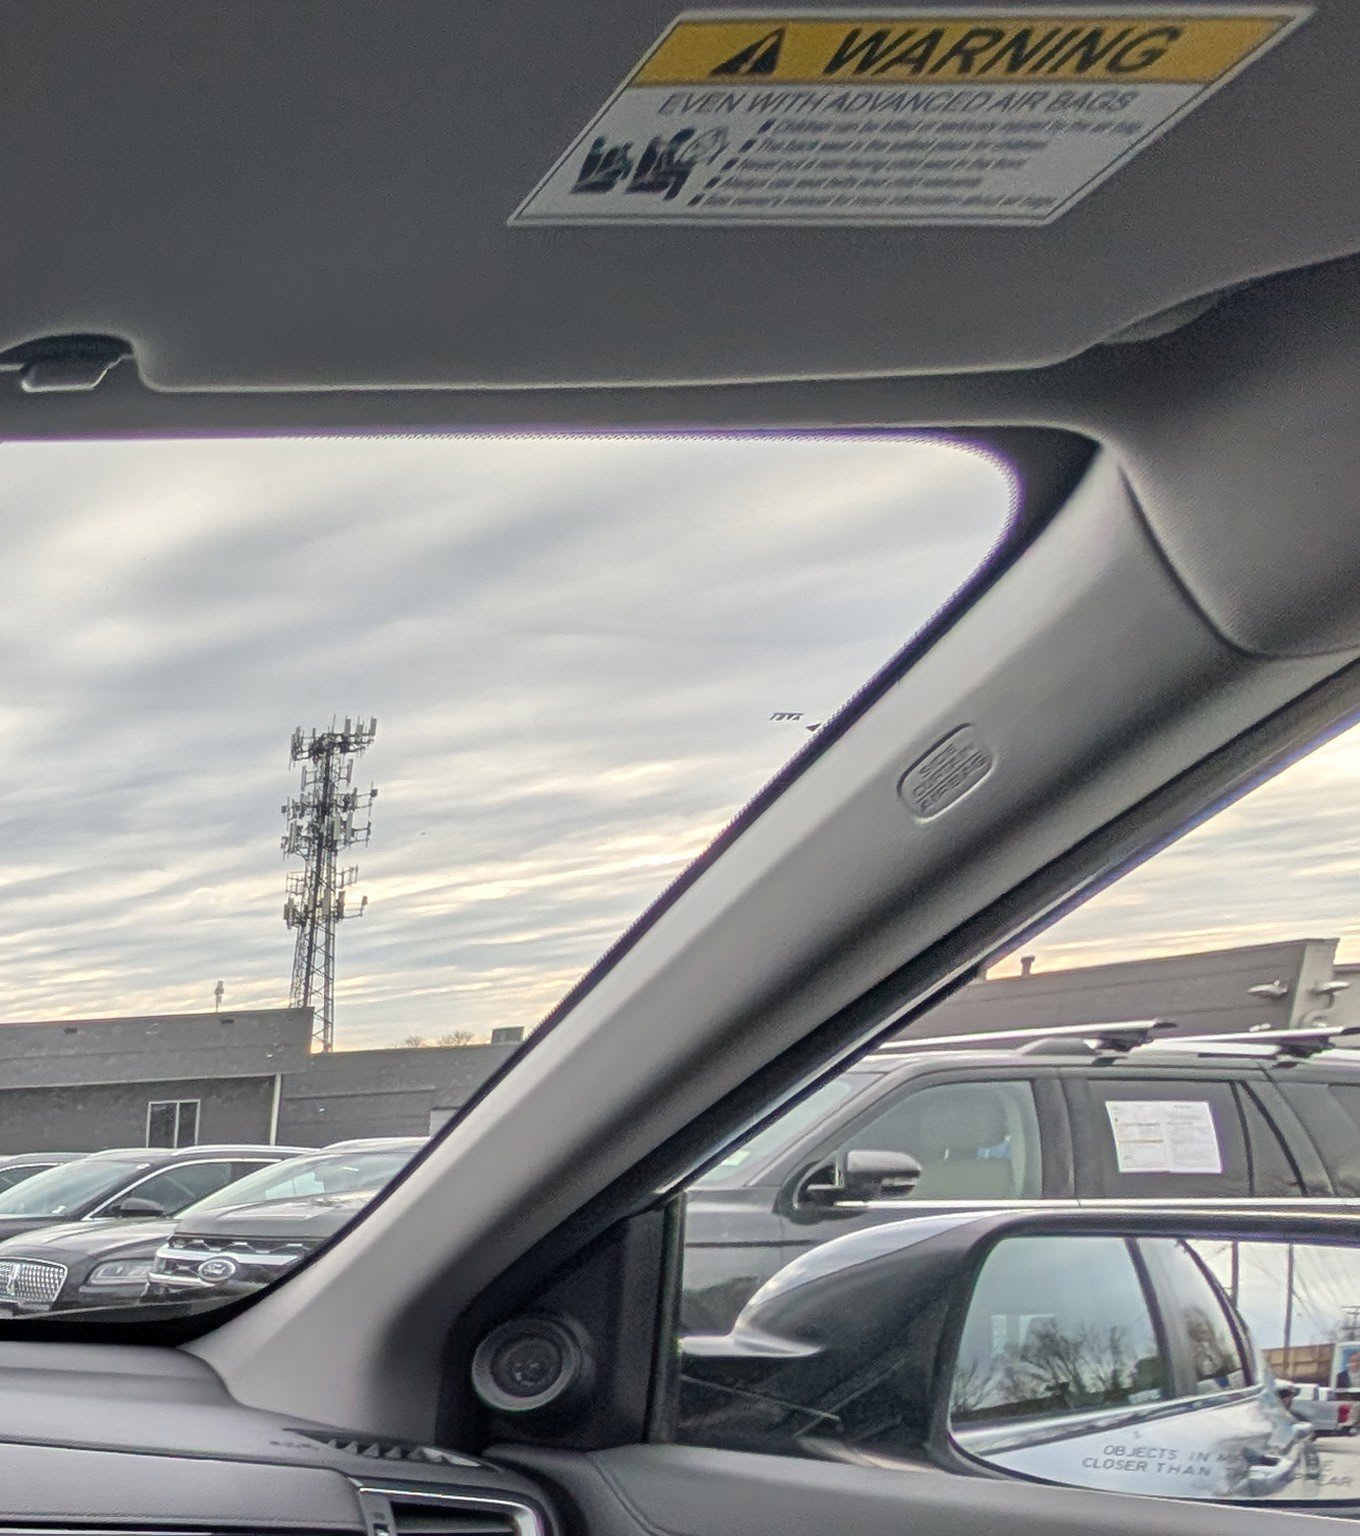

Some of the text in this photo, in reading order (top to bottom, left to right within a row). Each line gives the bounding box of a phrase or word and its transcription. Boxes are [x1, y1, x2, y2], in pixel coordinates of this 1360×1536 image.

[821, 26, 1183, 76] WARNING
[659, 91, 1140, 114] EVEN WITH ADVANCED AIR BAGS
[1103, 1444, 1178, 1460] OBJECTS
[1189, 1451, 1210, 1462] IN
[1081, 1457, 1212, 1477] CLOSER THAN
